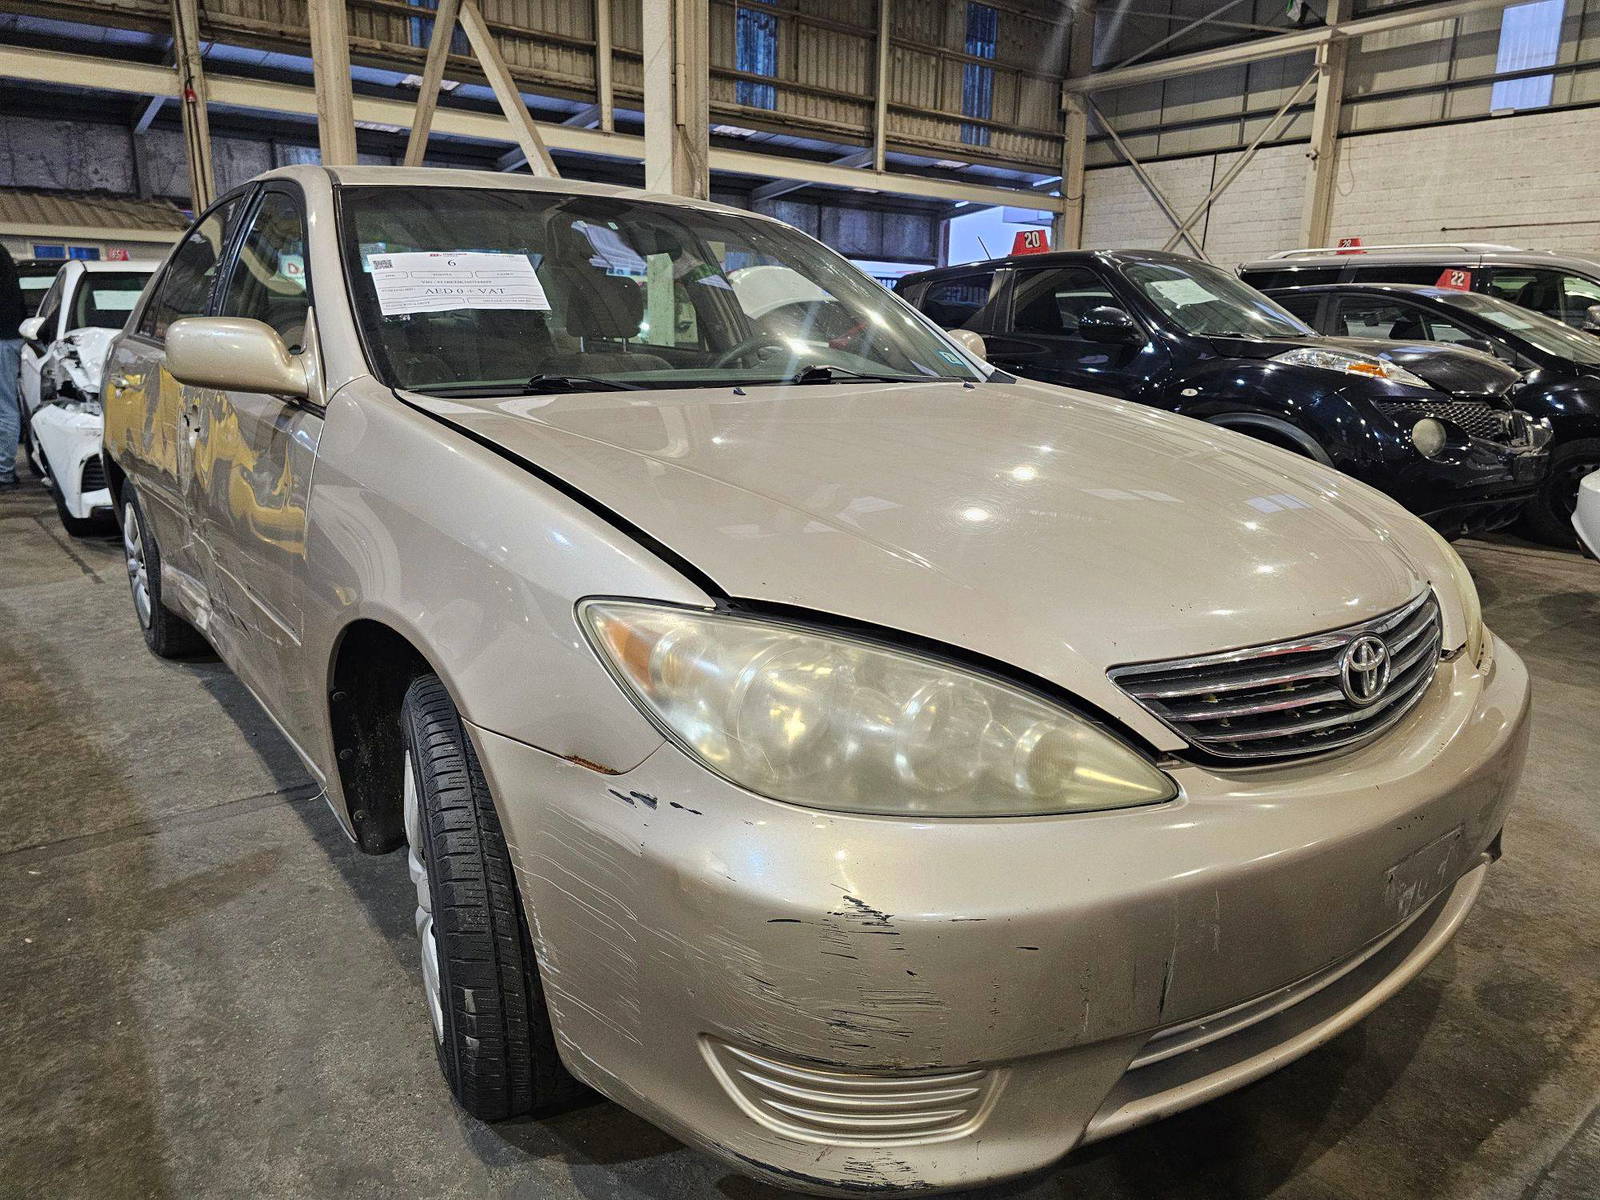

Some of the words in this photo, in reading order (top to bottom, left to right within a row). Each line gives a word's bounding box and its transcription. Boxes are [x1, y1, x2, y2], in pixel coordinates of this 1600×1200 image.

[1024, 231, 1041, 248] 20
[447, 259, 457, 267] 6
[1450, 271, 1465, 287] 22
